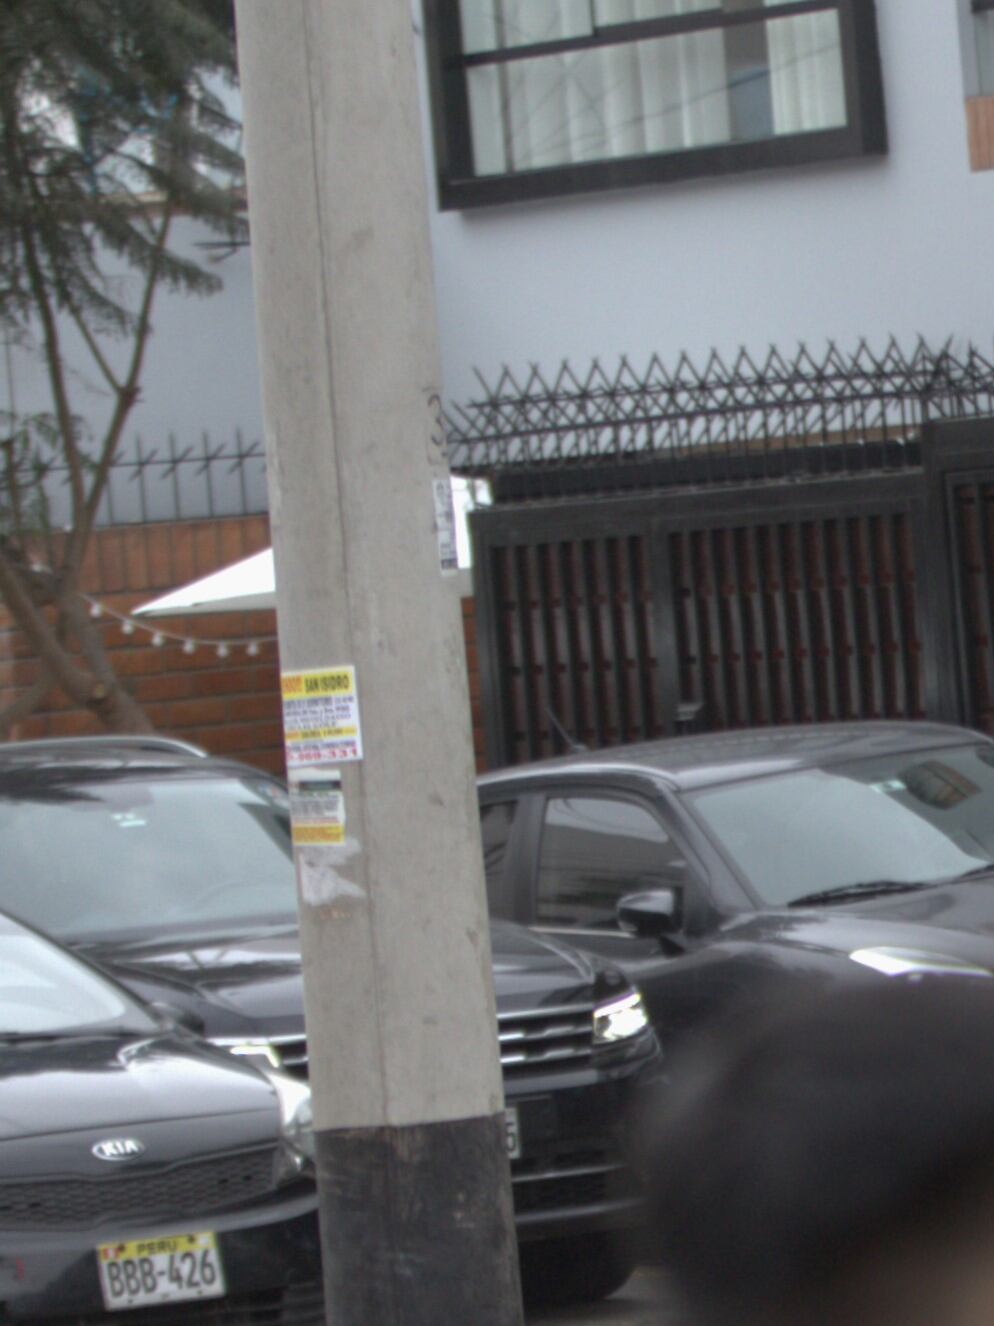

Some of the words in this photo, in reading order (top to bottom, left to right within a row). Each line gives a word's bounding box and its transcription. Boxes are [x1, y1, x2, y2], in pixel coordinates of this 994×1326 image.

[321, 674, 350, 692] ISIDRO
[101, 1139, 139, 1156] KIA
[137, 1240, 177, 1255] PERU
[108, 1249, 216, 1298] BBB-426
